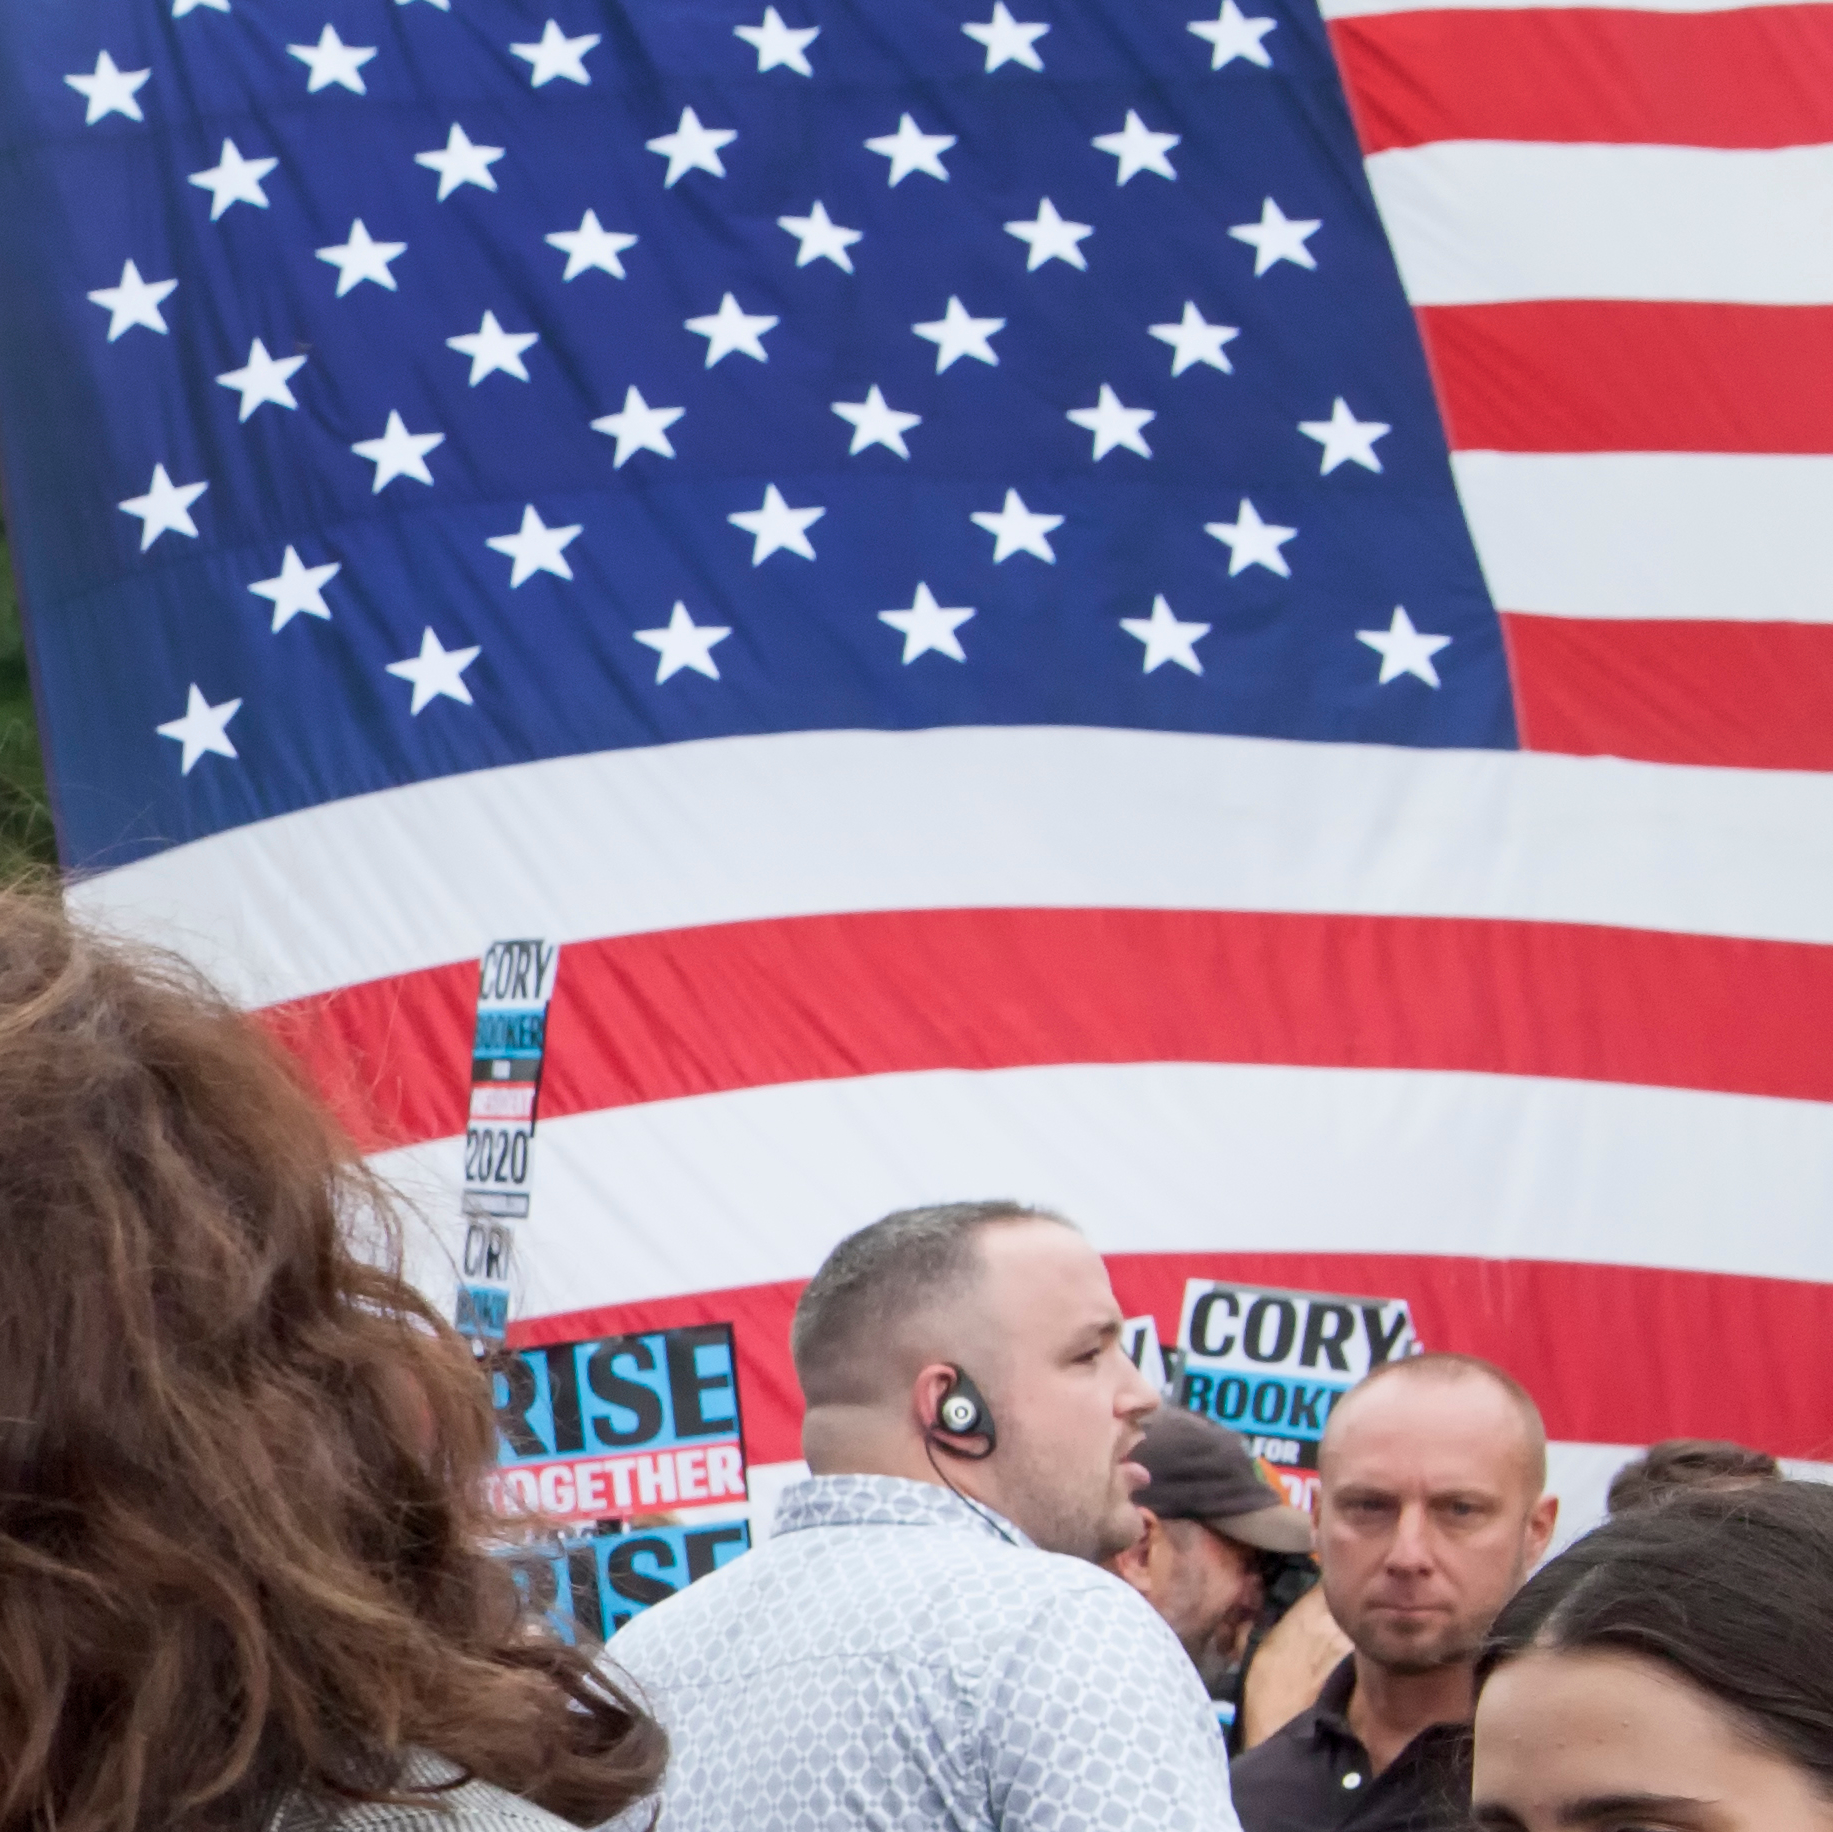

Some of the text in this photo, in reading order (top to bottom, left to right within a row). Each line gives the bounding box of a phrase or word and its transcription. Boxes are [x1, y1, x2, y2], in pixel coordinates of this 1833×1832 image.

[480, 940, 553, 1000] CORY
[466, 1129, 528, 1184] 2020
[1188, 1291, 1409, 1375] CORY
[491, 1324, 735, 1457] RISE
[1183, 1372, 1346, 1431] BOOK
[478, 1445, 746, 1519] TOGETHER
